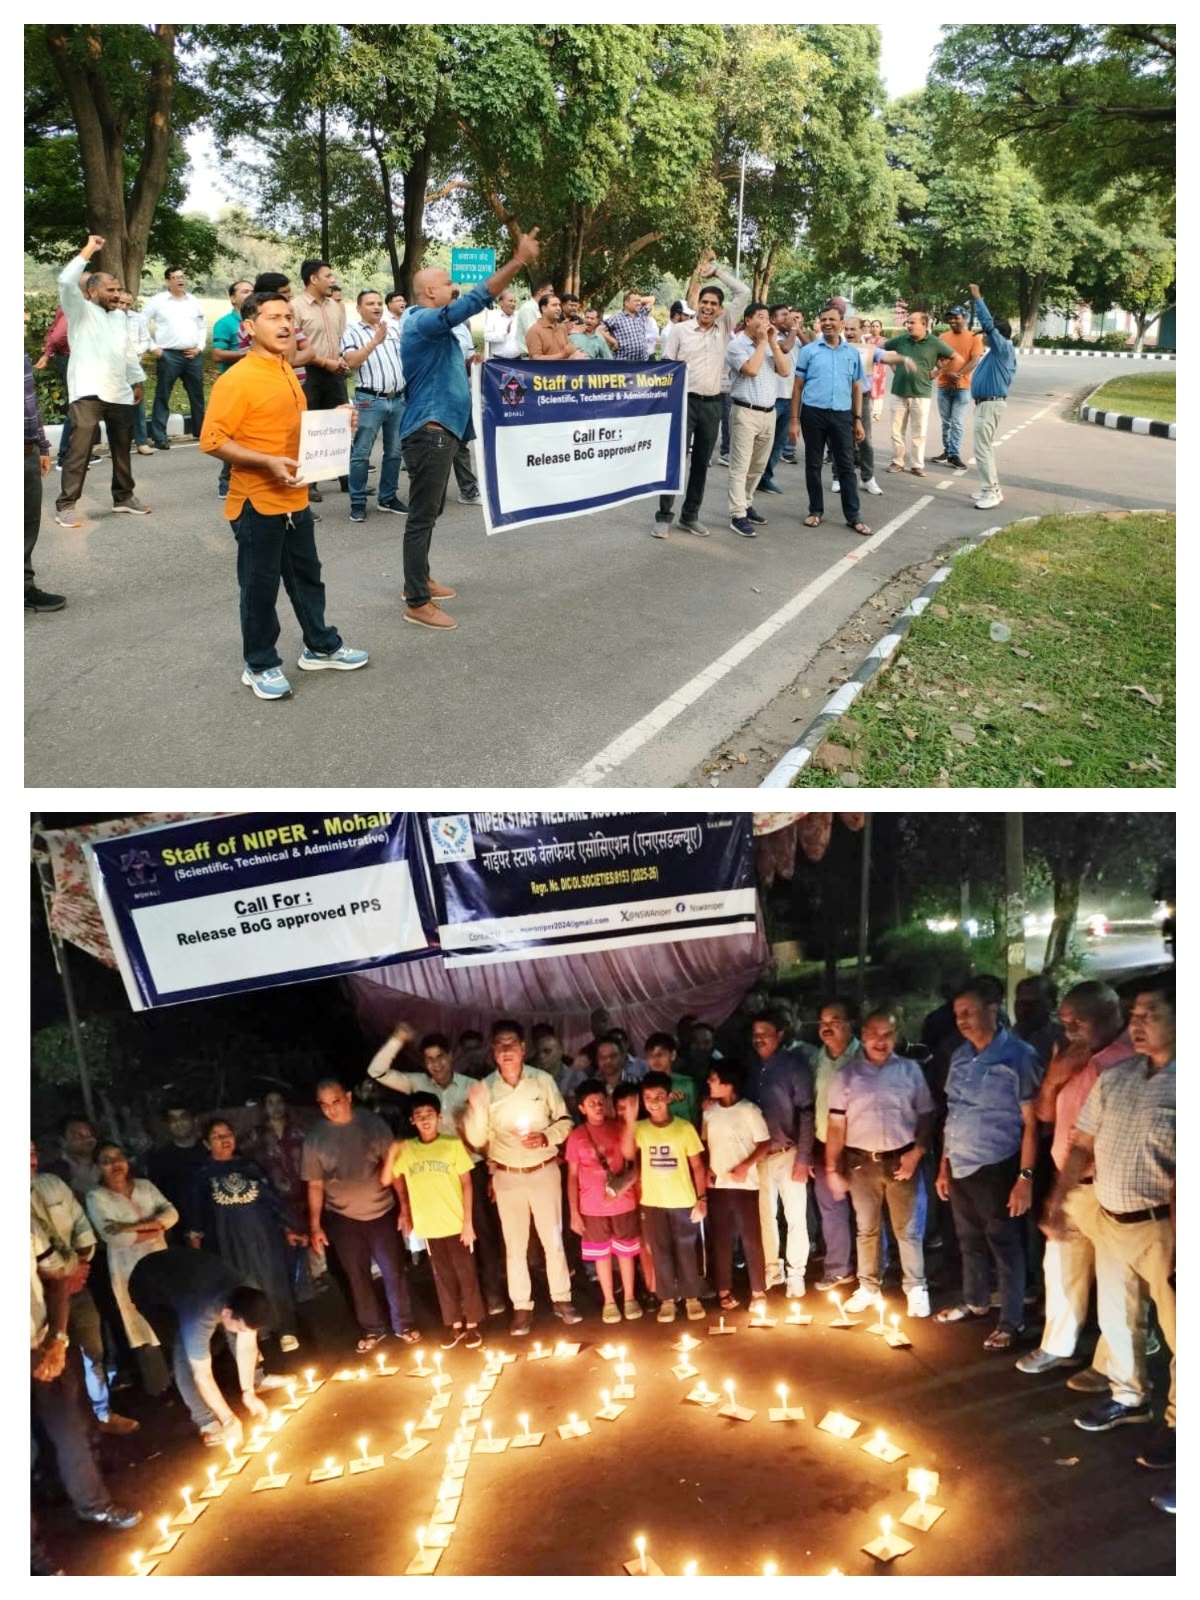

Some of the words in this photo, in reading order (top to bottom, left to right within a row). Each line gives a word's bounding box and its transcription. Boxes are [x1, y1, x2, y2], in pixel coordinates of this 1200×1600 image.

[533, 375, 566, 391] Staff
[571, 374, 584, 389] of
[588, 374, 626, 389] NIPER
[636, 373, 673, 387] Mohali
[537, 393, 578, 406] (Scientific,
[581, 392, 614, 402] Technical
[616, 392, 621, 400] &
[573, 429, 595, 443] Call
[599, 428, 616, 440] For
[527, 453, 570, 467] Release
[574, 448, 595, 461] BoG
[597, 444, 636, 459] approved
[637, 440, 651, 451] PPS
[474, 812, 506, 833] NIPER
[507, 812, 538, 829] STAFF
[161, 841, 210, 866] Staff
[217, 836, 236, 856] of
[242, 824, 308, 851] NIPER
[323, 812, 392, 836] Mohali
[174, 861, 234, 882] (Scientific,
[234, 849, 289, 868] Technical
[292, 848, 301, 858] &
[304, 831, 389, 856] Administrative)
[511, 847, 537, 868] स्टाफ
[538, 837, 576, 864] वेलफेयर
[531, 881, 548, 896] Regn.
[549, 879, 560, 892] No.
[234, 896, 268, 915] Call
[272, 893, 301, 908] For
[176, 927, 237, 946] Release
[240, 918, 272, 934] BoG
[277, 905, 347, 928] approved
[350, 898, 381, 915] PPS
[425, 1160, 449, 1175] YORK
